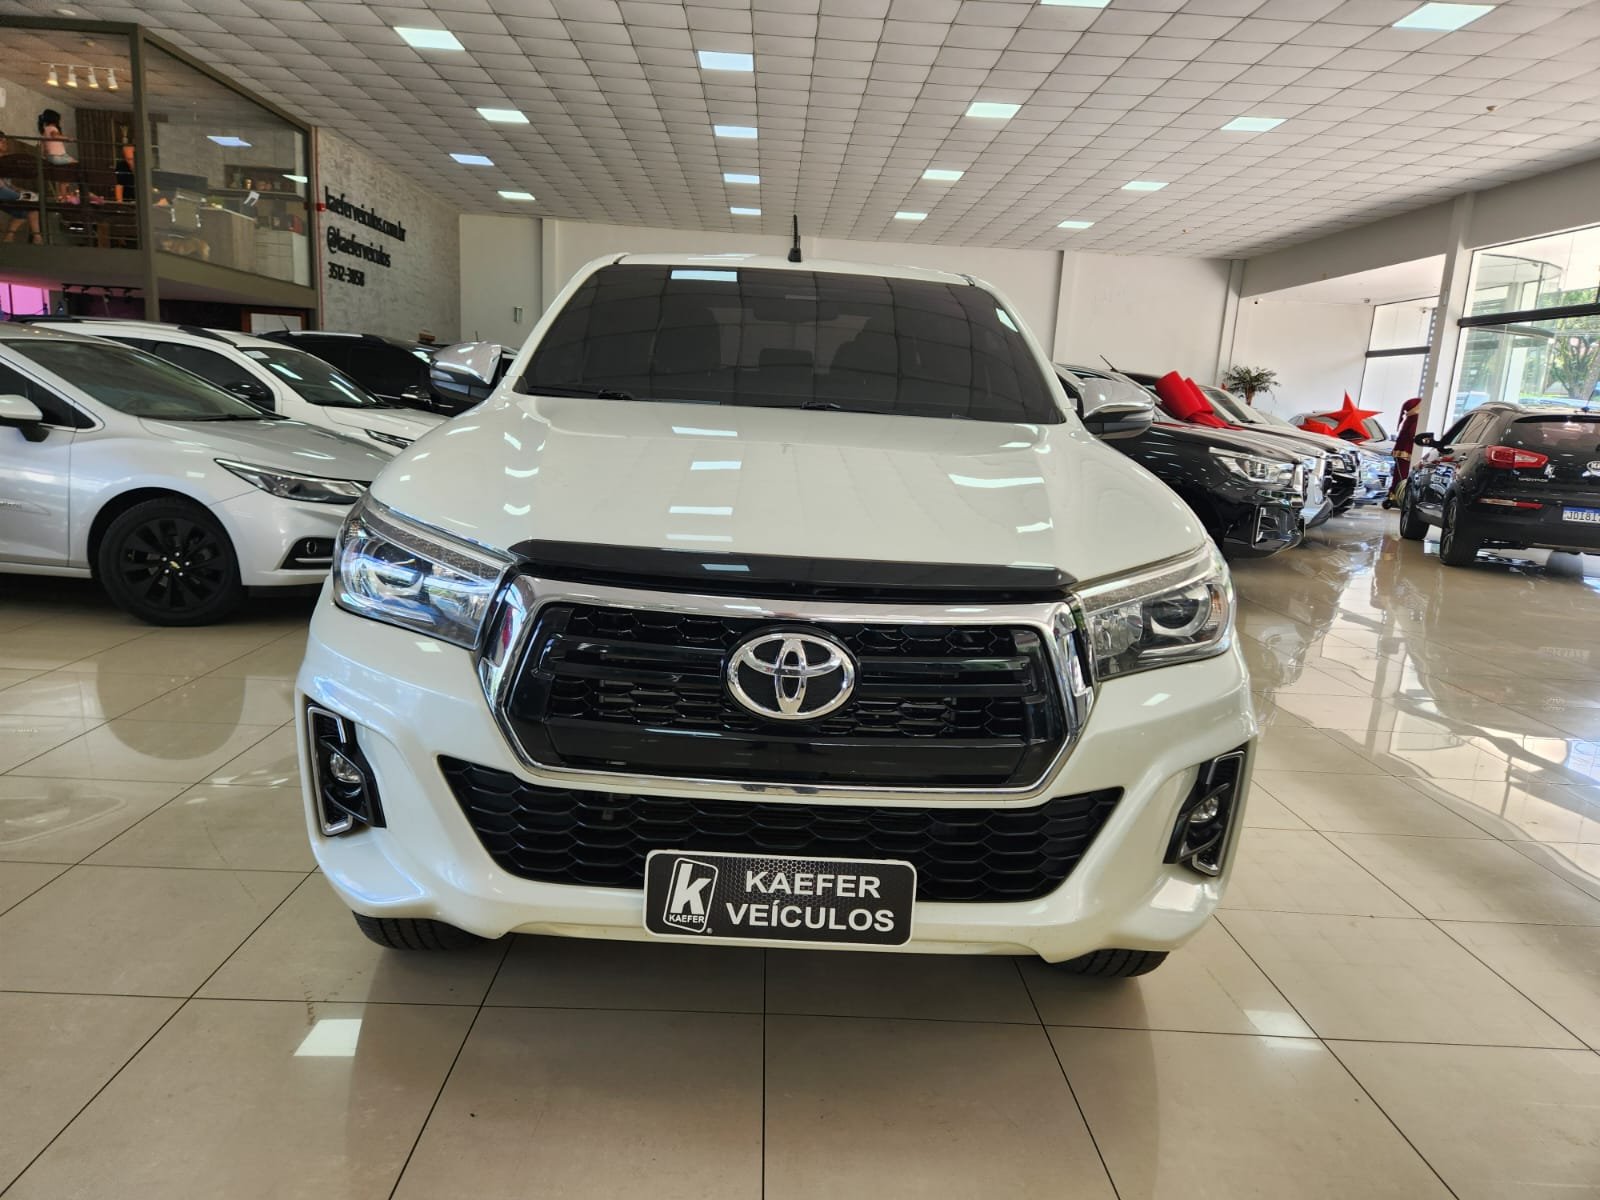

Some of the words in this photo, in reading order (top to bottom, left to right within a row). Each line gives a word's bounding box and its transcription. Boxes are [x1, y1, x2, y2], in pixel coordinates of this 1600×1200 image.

[746, 870, 881, 899] KAEFER
[669, 914, 705, 924] KAEFER
[726, 900, 895, 932] VEÍCULOS
